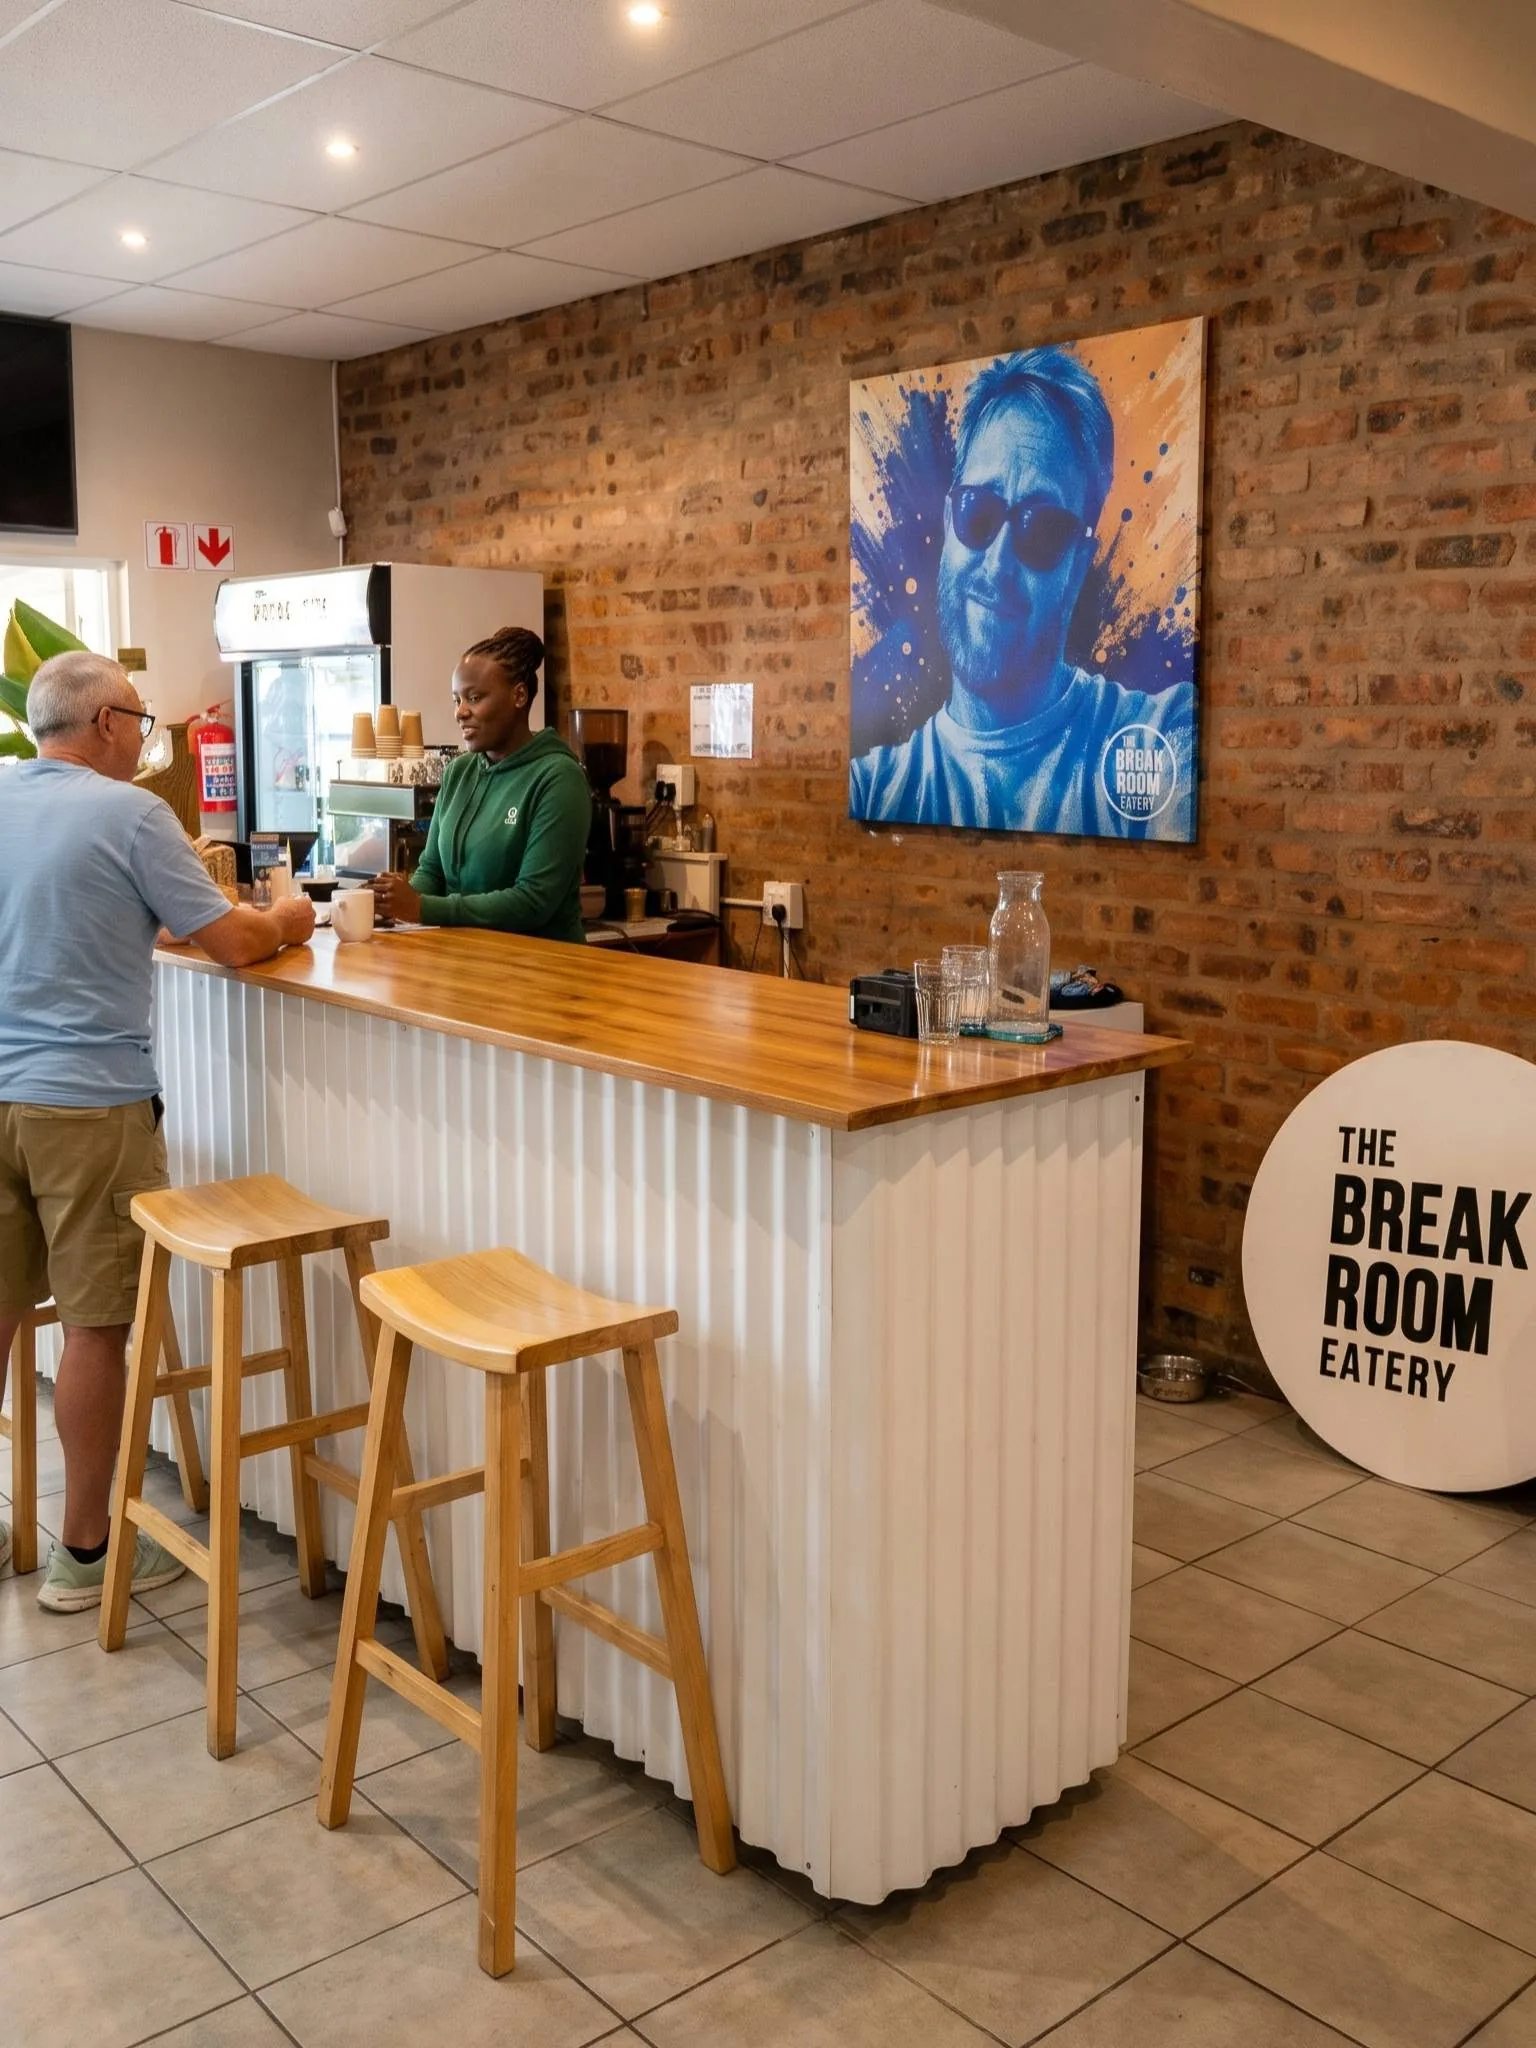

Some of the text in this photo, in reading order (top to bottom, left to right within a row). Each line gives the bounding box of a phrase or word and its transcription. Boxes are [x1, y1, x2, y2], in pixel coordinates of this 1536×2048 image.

[1116, 771, 1160, 796] ROOM
[1120, 795, 1155, 810] EATERY
[1339, 1126, 1397, 1167] THE
[1330, 1173, 1532, 1270] BREAK
[1323, 1254, 1494, 1356] ROOM
[1319, 1337, 1456, 1402] EATERY
